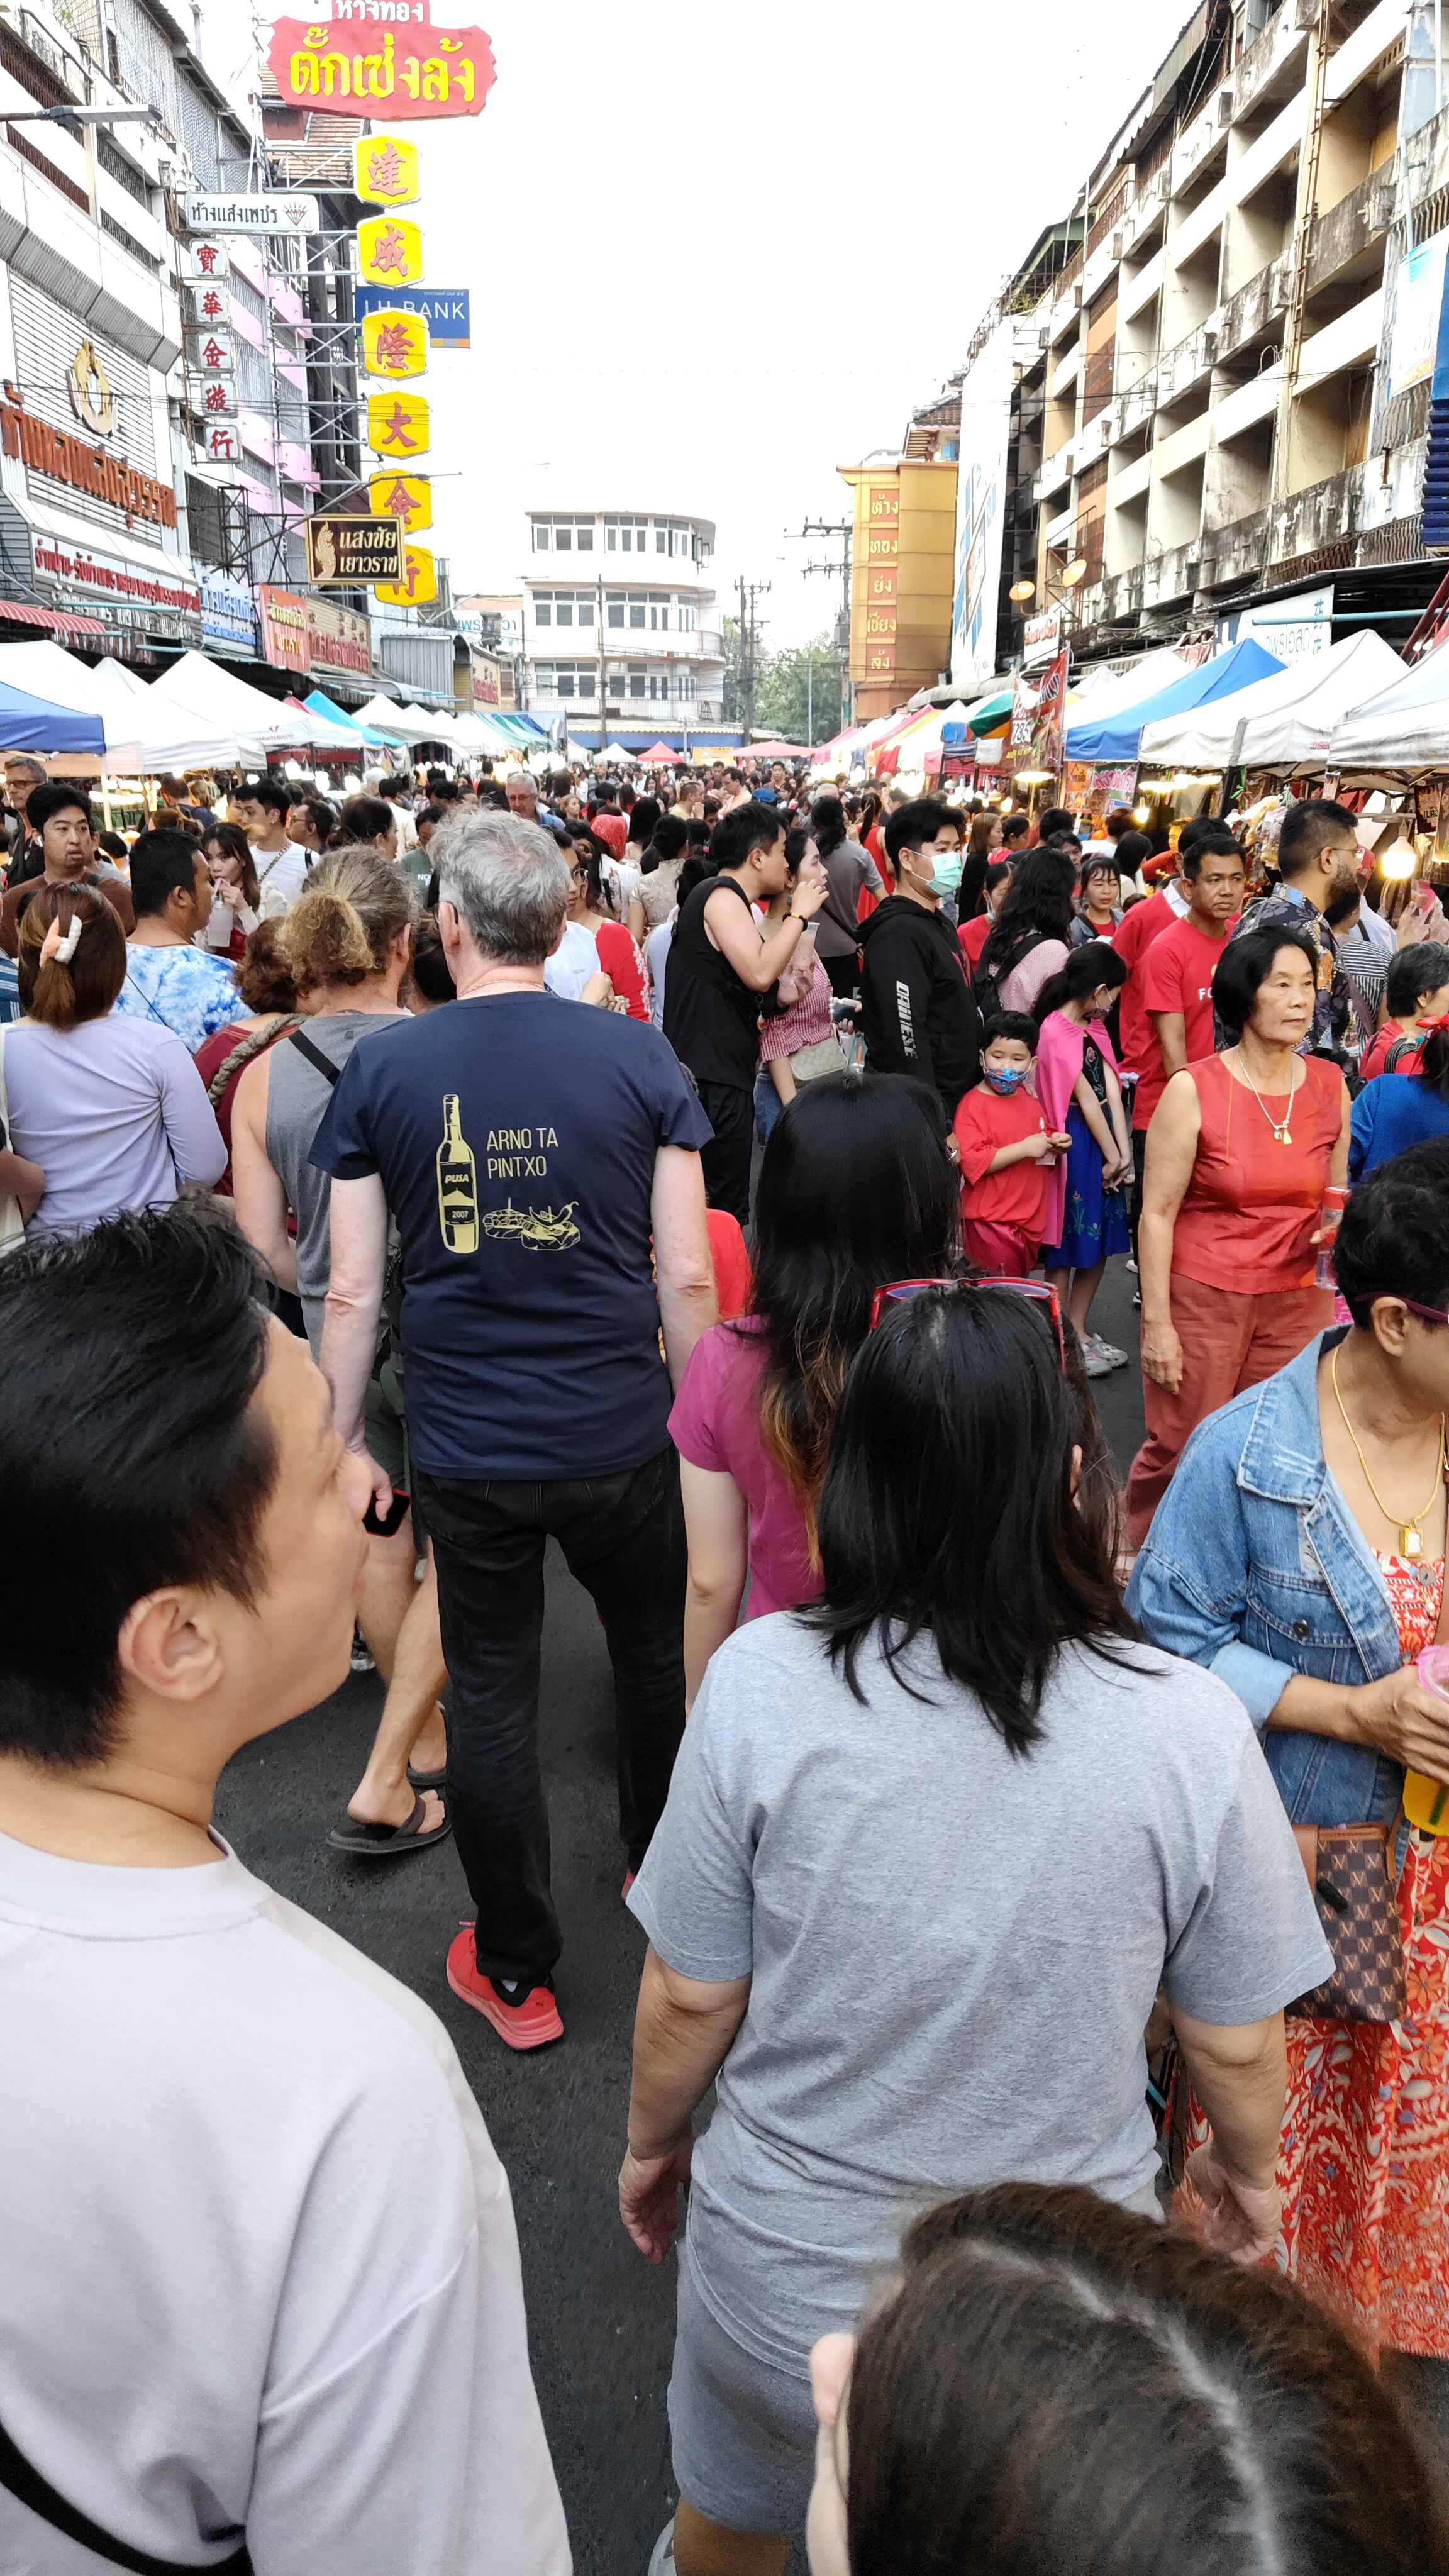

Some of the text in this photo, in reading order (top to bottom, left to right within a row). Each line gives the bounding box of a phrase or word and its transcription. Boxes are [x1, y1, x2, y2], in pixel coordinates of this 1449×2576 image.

[290, 26, 475, 102] ตั๊กเซ่งล้ง
[191, 202, 277, 224] ห้างแสงเพชร
[403, 301, 465, 319] BANK
[871, 494, 899, 515] ห้าง
[340, 526, 396, 549] แสงชัย
[870, 538, 897, 554] ทอง
[340, 555, 398, 574] เยาวราช
[874, 575, 892, 594] ย่ง
[867, 612, 896, 633] เชียง
[871, 650, 890, 670] ล้ง
[486, 1127, 559, 1152] ARNO TA
[487, 1156, 547, 1179] PINTXO
[444, 1174, 470, 1184] PUSA
